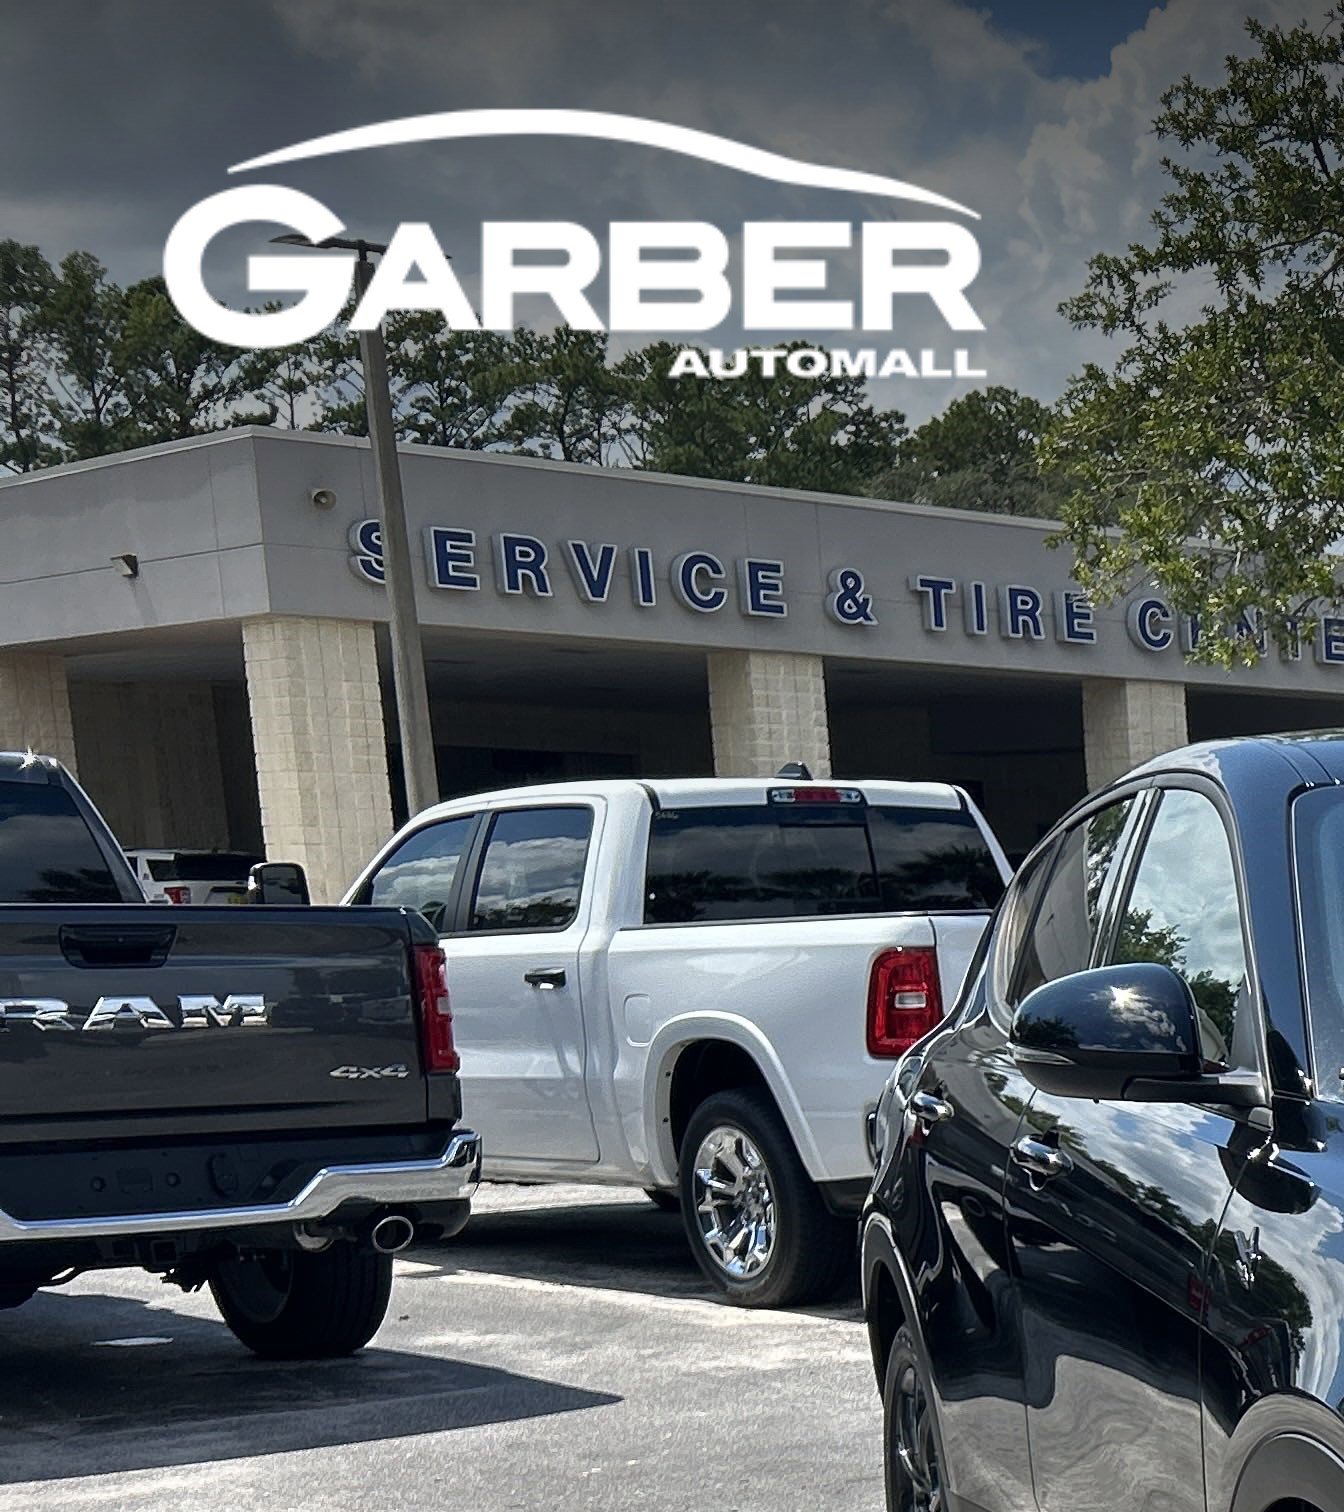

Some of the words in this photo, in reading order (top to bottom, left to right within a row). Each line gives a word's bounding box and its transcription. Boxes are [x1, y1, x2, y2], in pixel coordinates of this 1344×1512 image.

[829, 567, 878, 626] &
[909, 575, 1097, 645] TIRE
[0, 994, 268, 1032] RAM
[329, 1063, 409, 1080] 4x4
